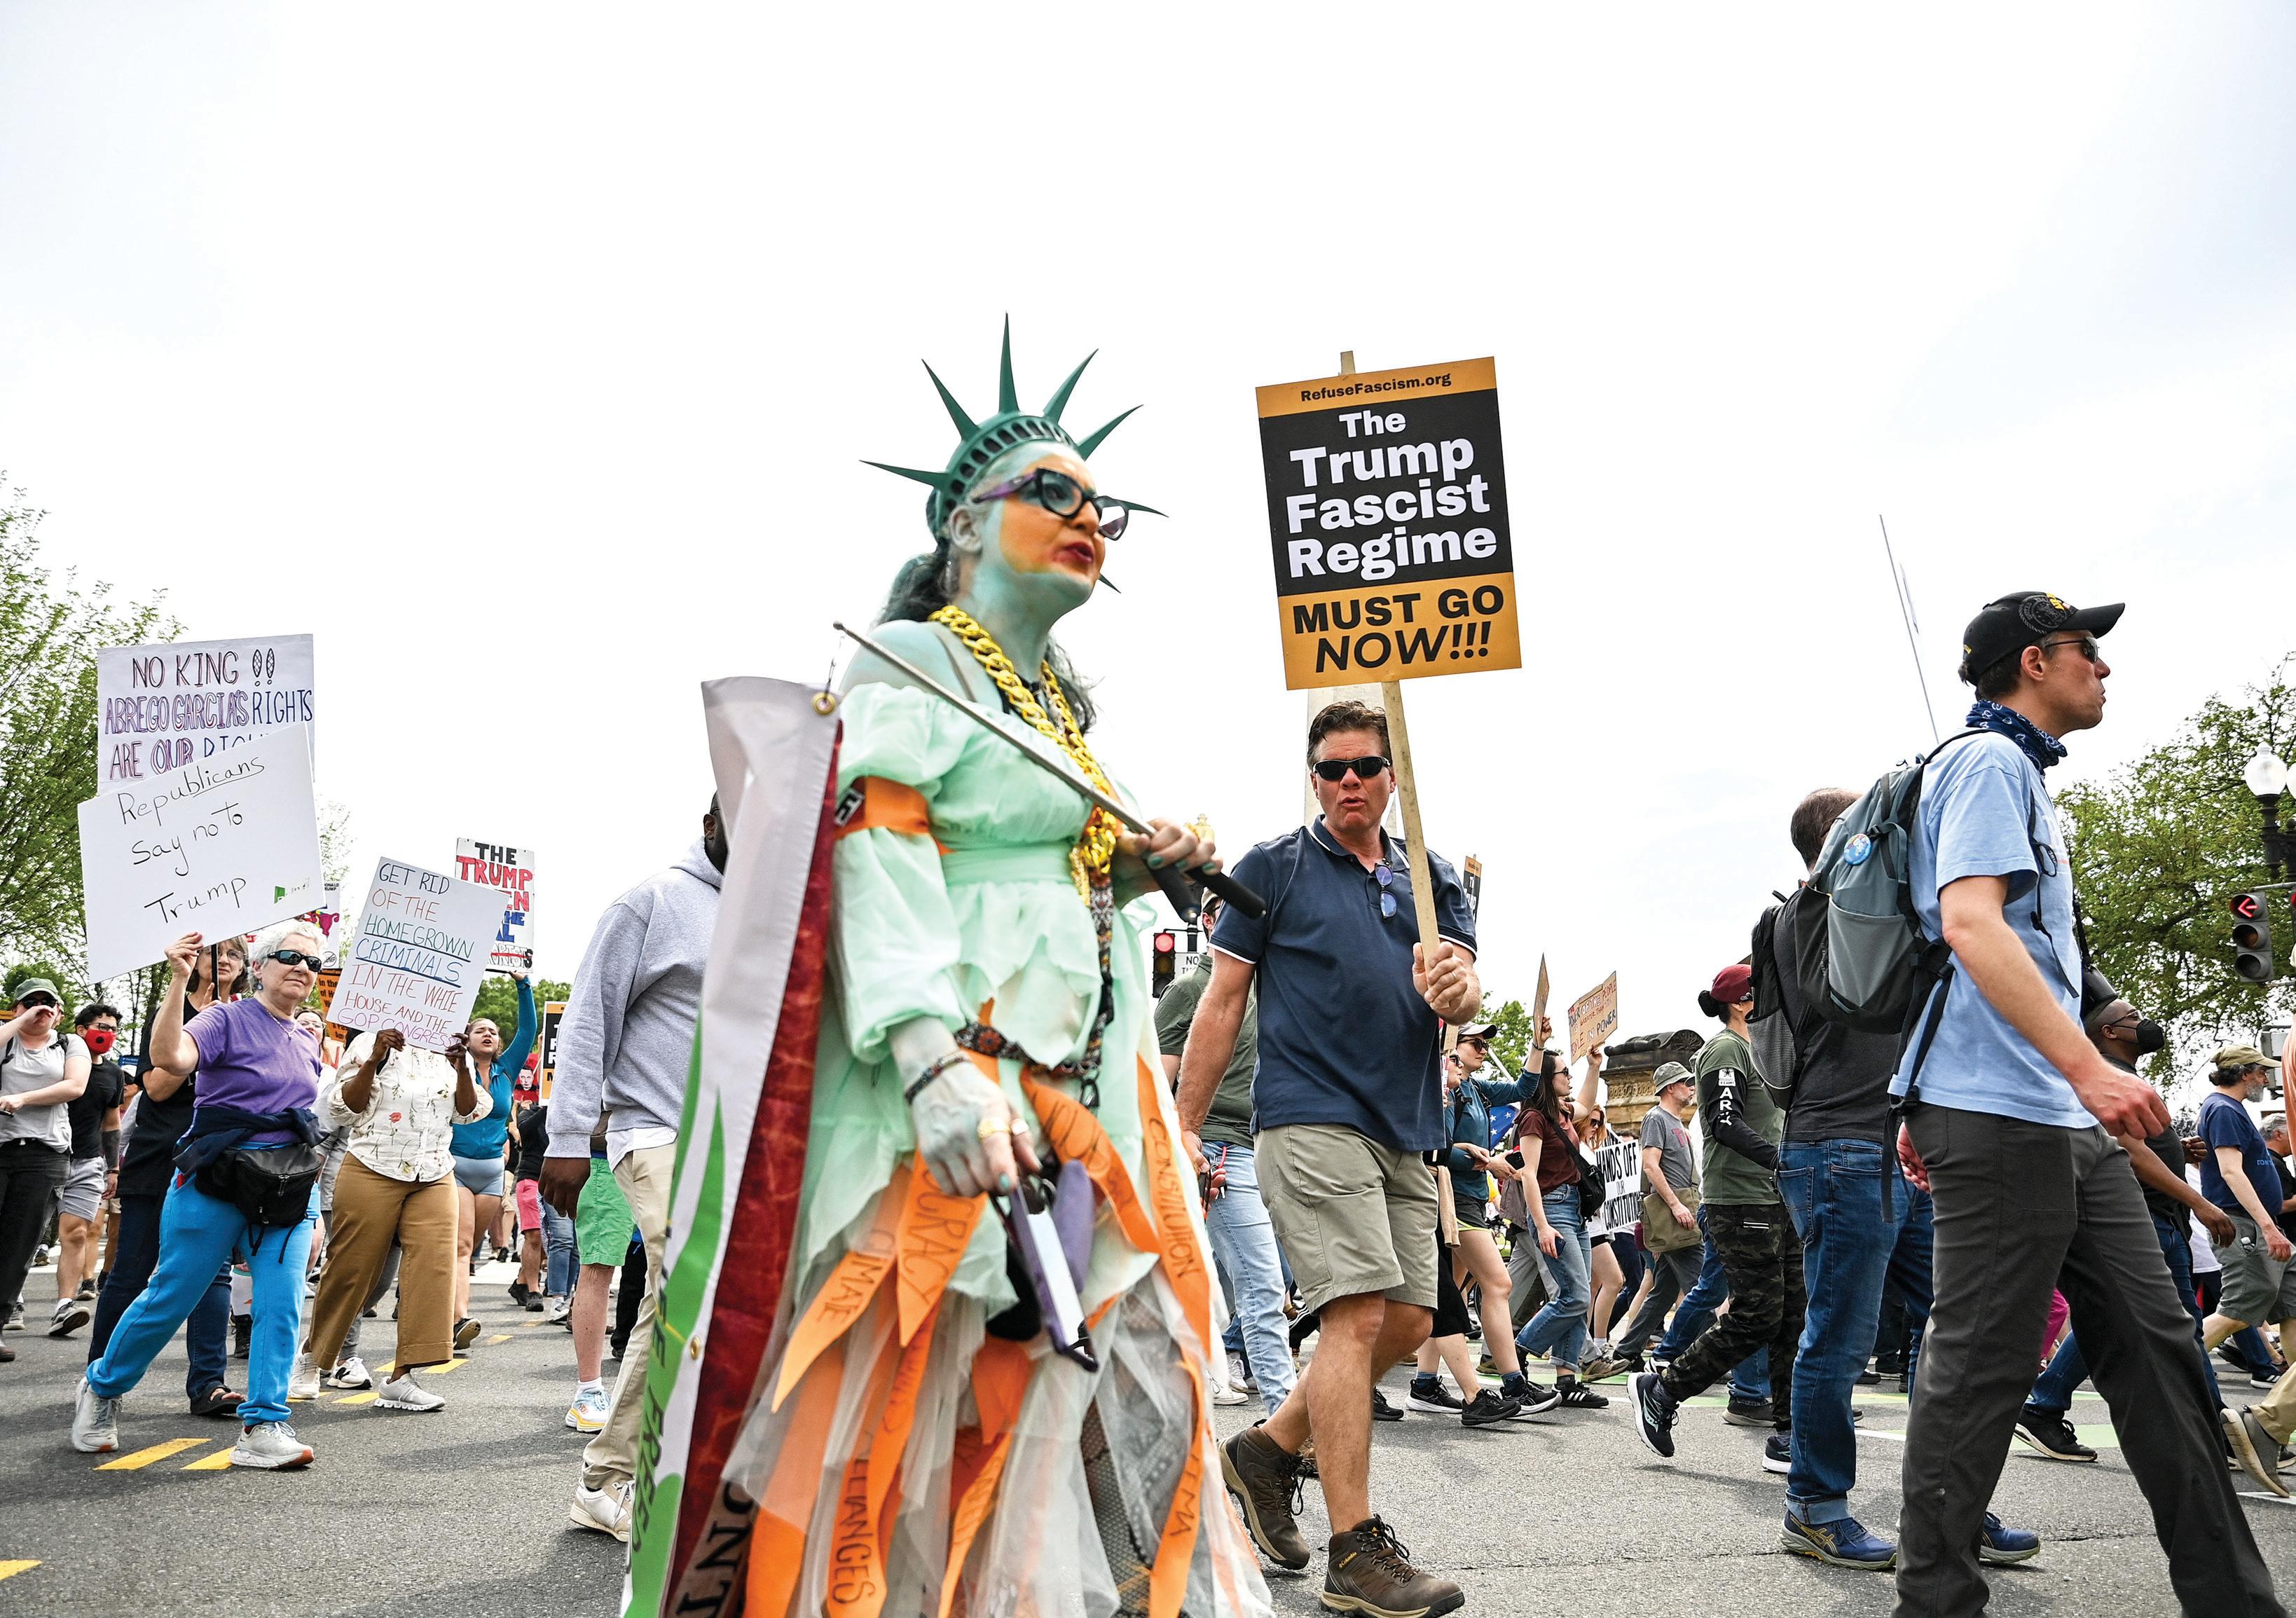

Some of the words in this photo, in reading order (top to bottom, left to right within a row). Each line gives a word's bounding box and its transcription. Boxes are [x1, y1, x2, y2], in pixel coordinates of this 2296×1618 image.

[1300, 373, 1452, 402] RefuseFascism.org
[1339, 409, 1407, 438] The
[1289, 438, 1475, 488] Trump
[1286, 474, 1491, 534] Fascist
[1287, 526, 1497, 581] Regime
[1293, 592, 1421, 634] MUST
[1438, 585, 1504, 619] GO
[1316, 621, 1492, 673] NOW!!!
[133, 655, 167, 688] NO
[177, 651, 239, 687] KING
[105, 696, 170, 734] ABREGO
[172, 690, 249, 732] GARCIA'S
[252, 690, 313, 725] RIGHTS
[109, 740, 144, 780] ARE
[151, 738, 194, 774] OUR
[118, 757, 265, 826] Republicans
[193, 824, 219, 841] no
[456, 856, 534, 891] TRUMP
[475, 842, 516, 865] THE
[379, 863, 415, 885] GET
[419, 870, 451, 895] RID
[144, 878, 247, 924] Trump
[372, 889, 402, 910] OF
[405, 896, 440, 923] THE
[356, 938, 464, 982] CRIMINALS
[1185, 956, 1199, 965] NO
[348, 964, 383, 989] IN
[387, 973, 425, 999] THE
[337, 1008, 380, 1029] GOP
[345, 990, 392, 1015] HOUSE
[394, 1006, 424, 1023] AND
[425, 1014, 453, 1035] THE
[1596, 1146, 1623, 1183] HANDS
[1623, 1142, 1637, 1178] OFF
